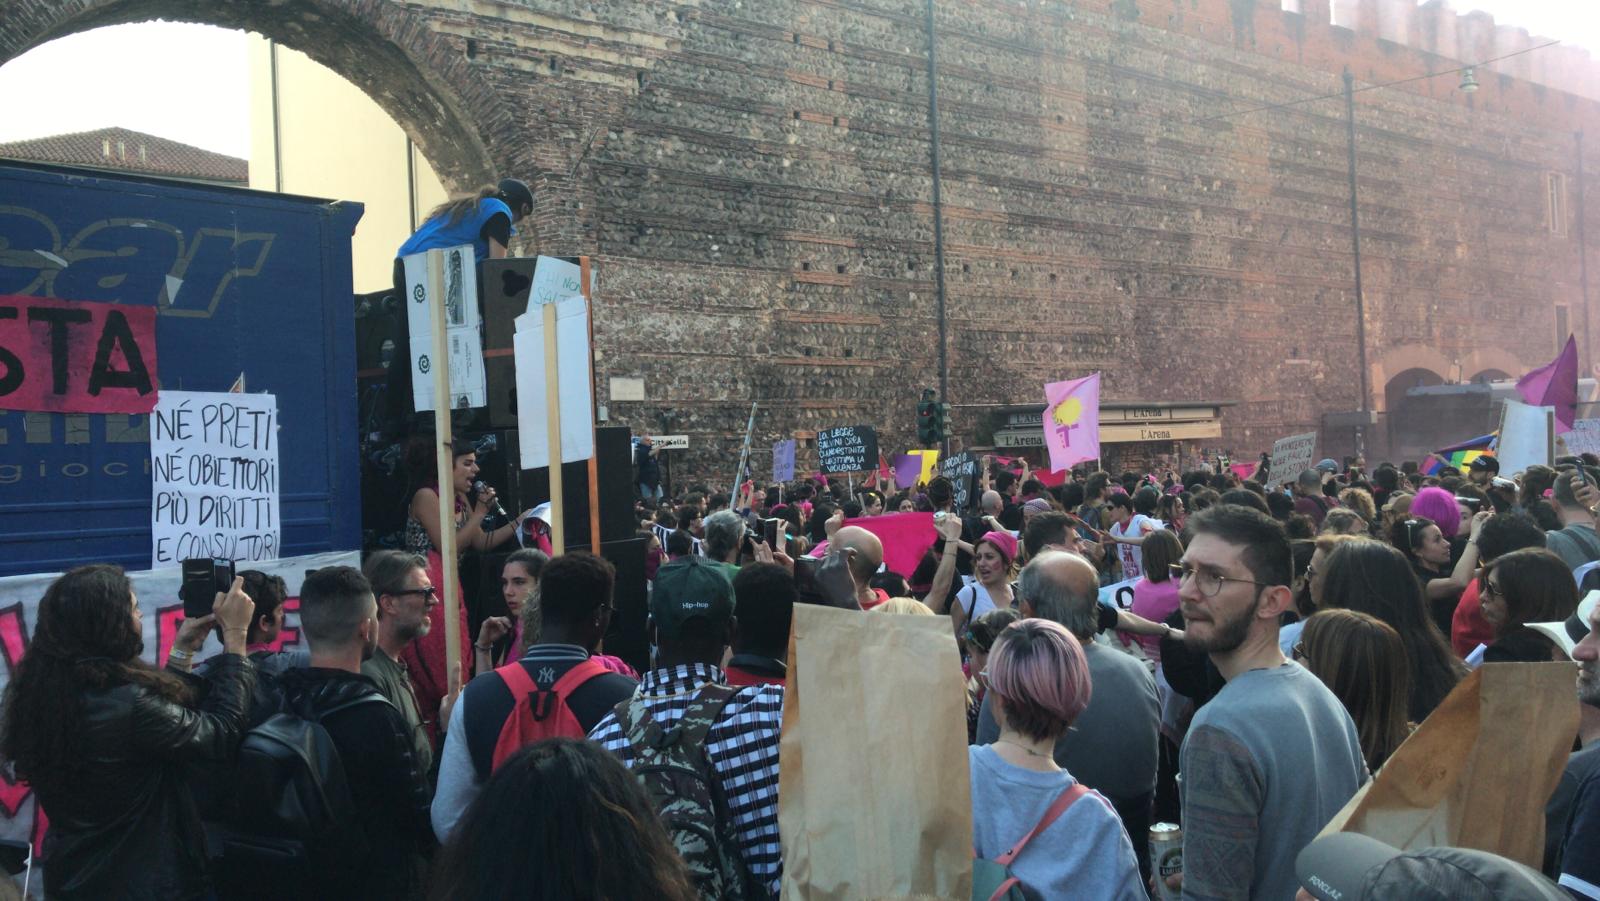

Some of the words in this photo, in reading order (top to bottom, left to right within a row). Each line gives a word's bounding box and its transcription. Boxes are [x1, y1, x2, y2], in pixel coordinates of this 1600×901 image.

[156, 399, 193, 441] NÉ
[201, 402, 272, 451] PRETI
[1016, 414, 1043, 423] L'Are
[1006, 435, 1043, 446] L'Arena
[1141, 429, 1172, 440] L'Arena
[0, 459, 150, 484] gioc
[154, 447, 185, 483] NÉ
[156, 490, 188, 525] PIÙ
[199, 495, 272, 530] DIRITTI
[157, 537, 171, 562] E
